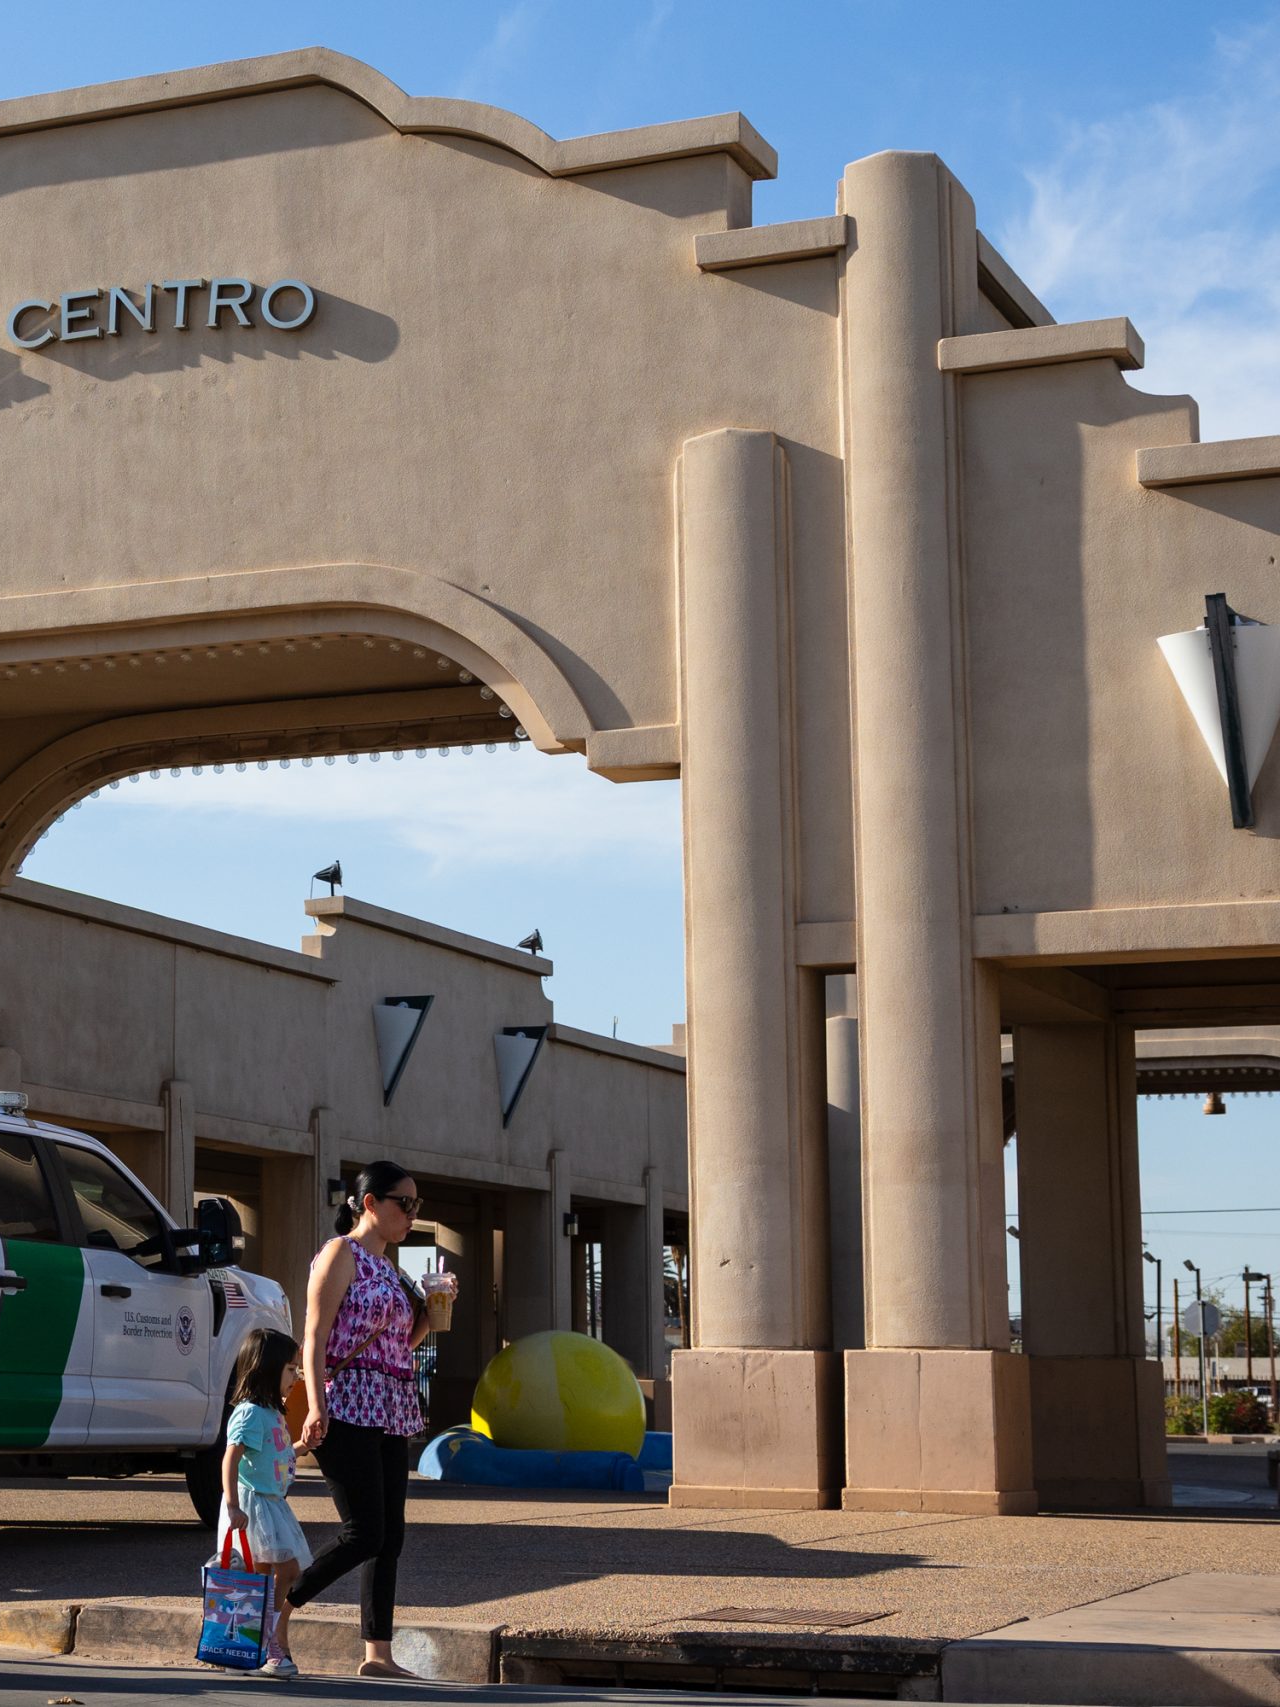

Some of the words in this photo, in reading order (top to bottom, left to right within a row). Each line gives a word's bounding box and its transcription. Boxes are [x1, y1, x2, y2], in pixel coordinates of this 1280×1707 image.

[5, 277, 319, 350] CENTRO
[124, 1311, 135, 1322] U.S.
[136, 1312, 160, 1325] Customs
[161, 1314, 172, 1326] and
[122, 1324, 142, 1337] Border
[144, 1326, 172, 1339] Protection
[200, 1645, 224, 1654] SPACE
[225, 1648, 257, 1659] NEEDLE
